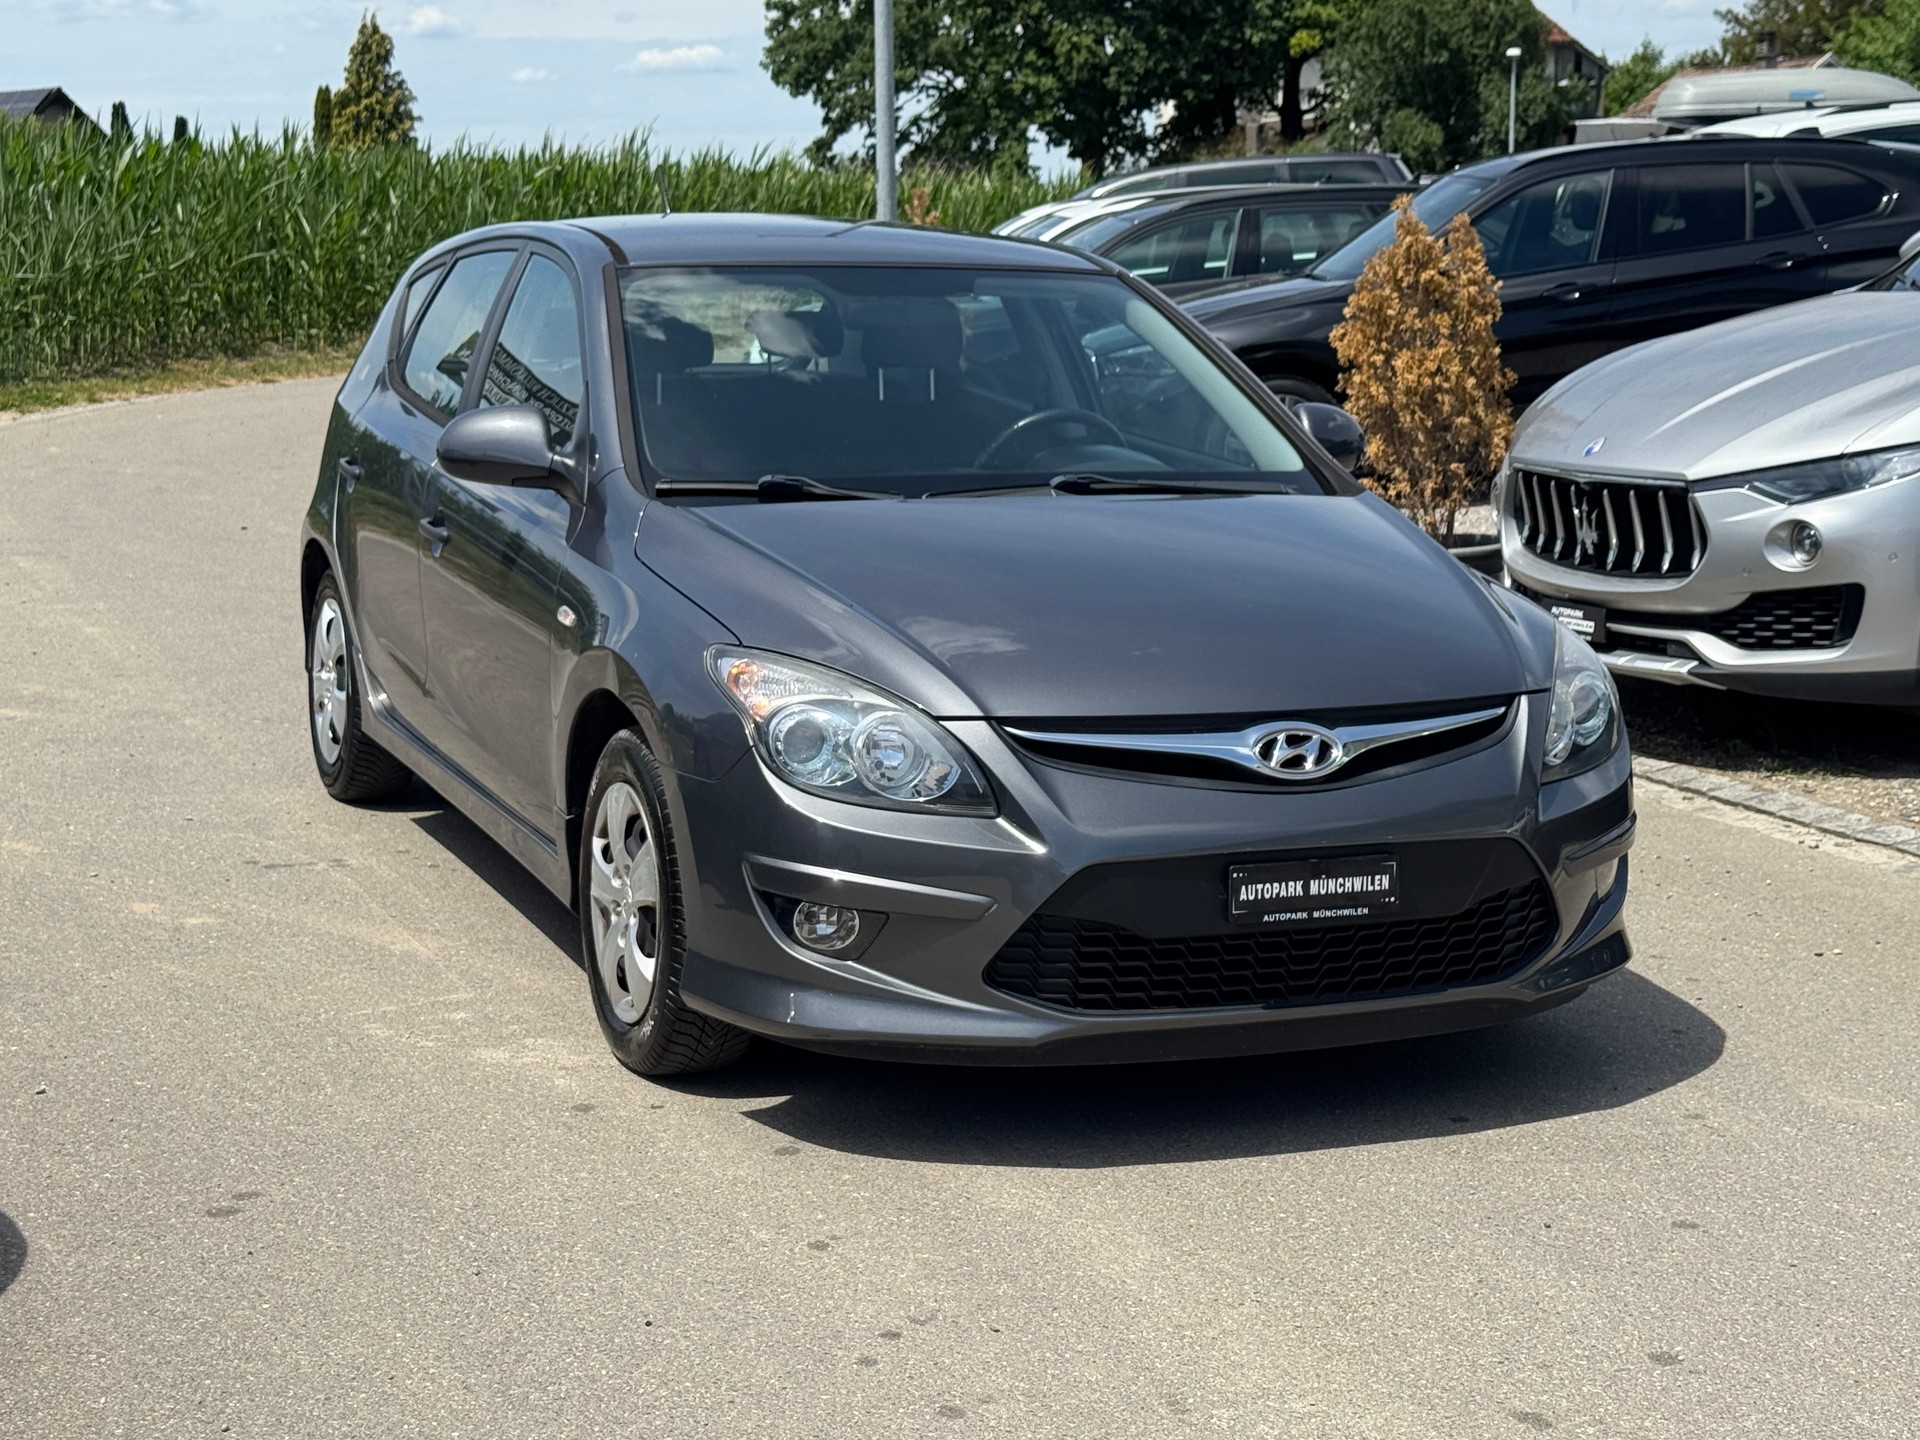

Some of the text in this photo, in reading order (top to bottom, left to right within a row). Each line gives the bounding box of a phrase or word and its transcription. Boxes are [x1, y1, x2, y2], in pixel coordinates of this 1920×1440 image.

[1239, 874, 1390, 902] AUTOPARK MÜNCHWILEN
[1262, 907, 1369, 922] AUTOPARK MÜNCHWILEN
